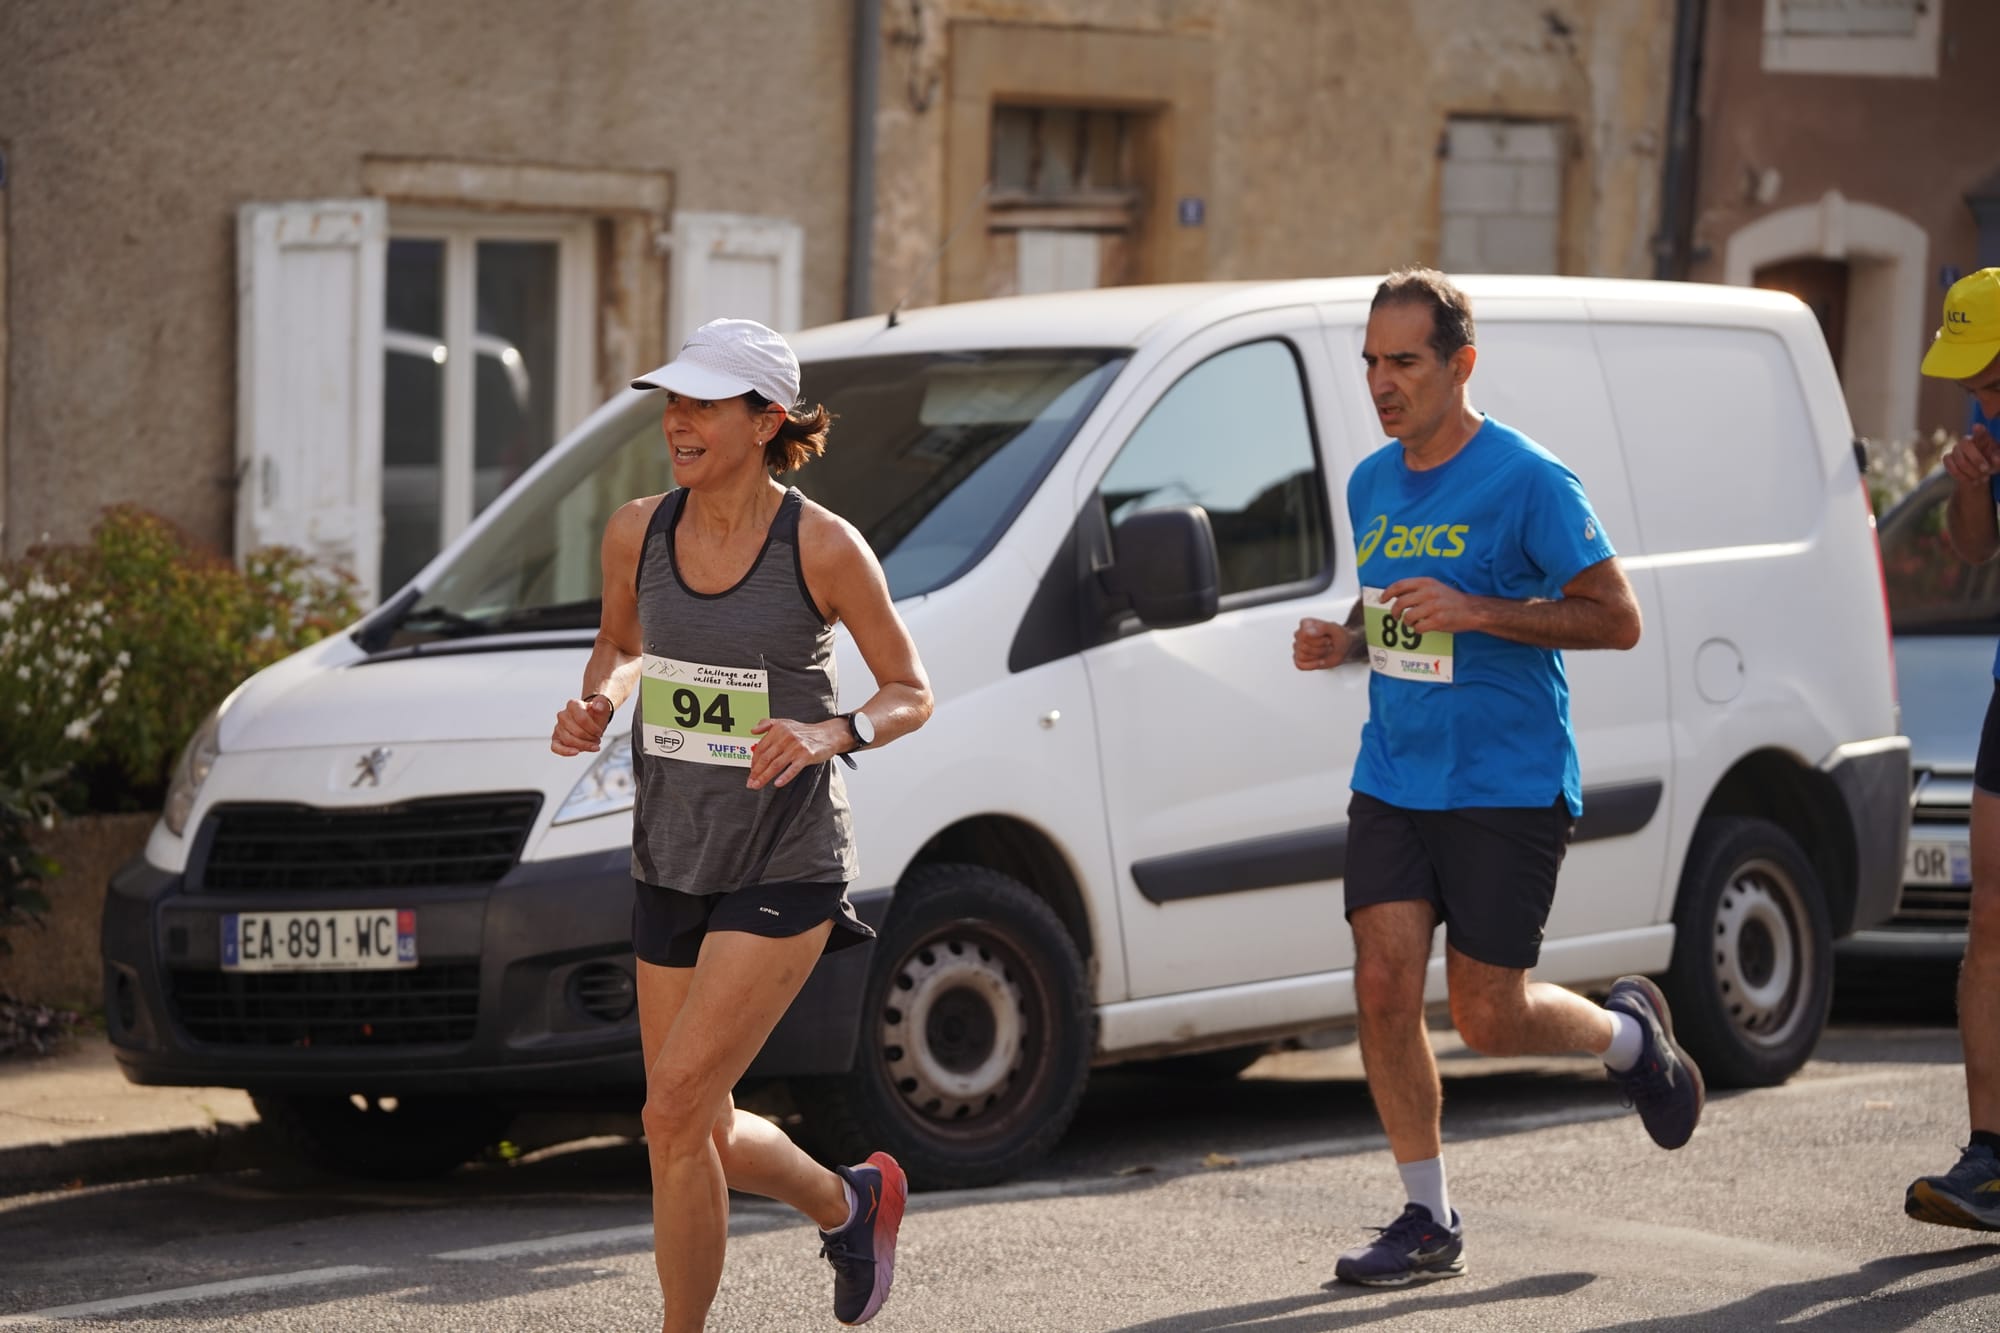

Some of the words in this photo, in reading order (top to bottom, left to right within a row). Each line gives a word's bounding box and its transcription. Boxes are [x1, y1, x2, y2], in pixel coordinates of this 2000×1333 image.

[1948, 310, 1971, 323] LCL
[1382, 613, 1422, 650] 89
[697, 667, 738, 680] Challenge
[743, 672, 757, 680] des
[693, 676, 721, 685] vallées
[673, 688, 735, 733] 94
[655, 735, 680, 746] BFP
[707, 743, 747, 754] TUFF'S
[711, 751, 751, 760] Aventure
[242, 916, 392, 960] EA-891-WC
